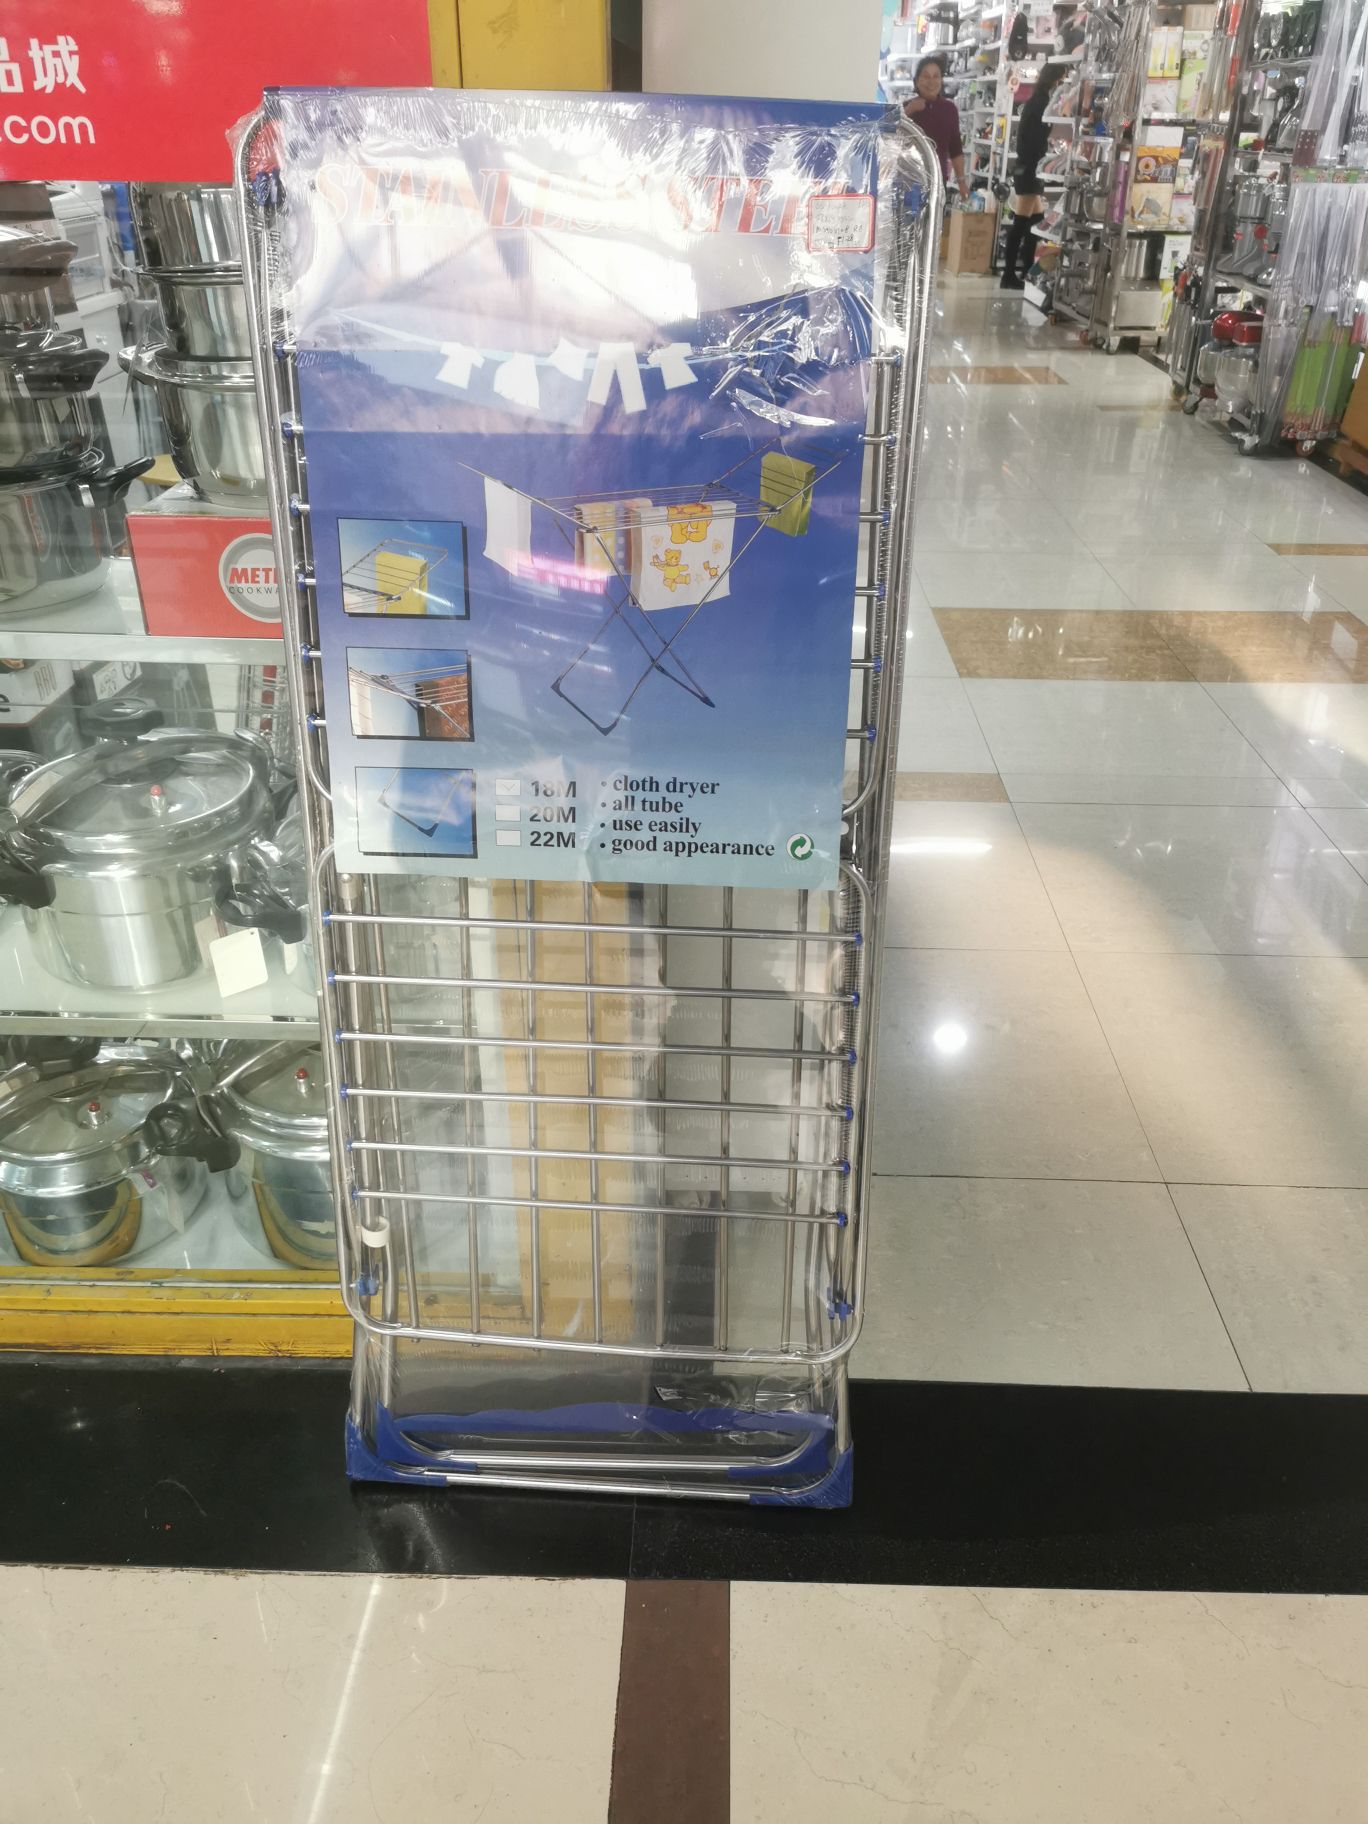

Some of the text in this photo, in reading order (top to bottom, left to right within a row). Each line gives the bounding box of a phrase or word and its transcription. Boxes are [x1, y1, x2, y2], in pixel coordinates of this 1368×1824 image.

[664, 174, 848, 237] STEE
[530, 780, 577, 798] 18M
[612, 774, 720, 798] cloth dryer
[612, 795, 684, 813] all tube
[529, 806, 577, 823] 20M
[612, 817, 702, 838] use easily
[529, 830, 577, 849] 22M
[611, 835, 776, 858] good appearance
